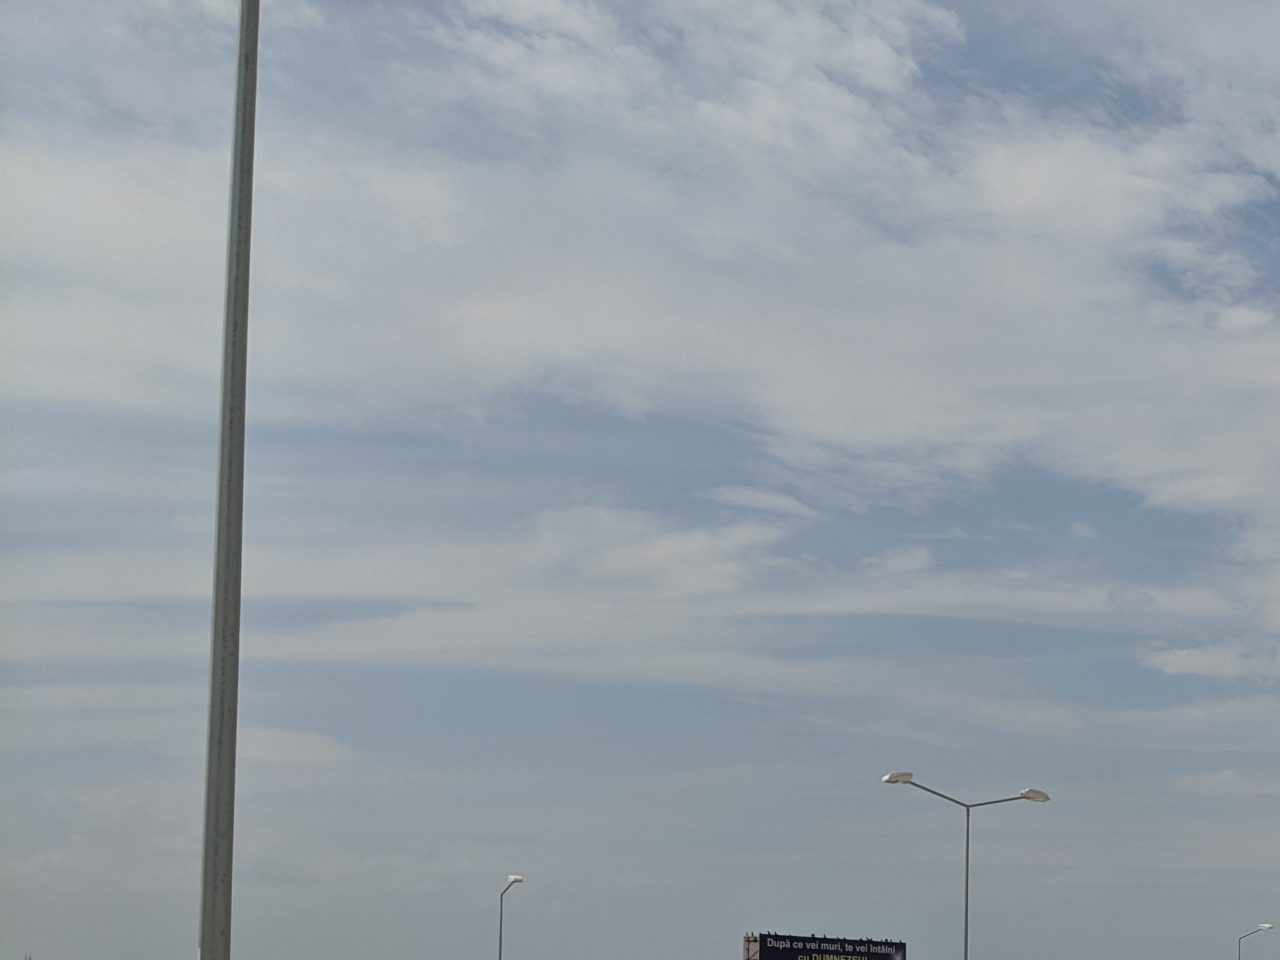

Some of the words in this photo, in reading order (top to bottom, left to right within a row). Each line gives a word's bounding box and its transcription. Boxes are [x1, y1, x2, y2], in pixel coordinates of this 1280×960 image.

[767, 938, 791, 951] După
[792, 941, 804, 949] ce
[805, 941, 819, 950] vei
[821, 942, 843, 952] muri,
[845, 944, 854, 952] te
[855, 944, 868, 953] vei
[870, 944, 896, 954] întâlni
